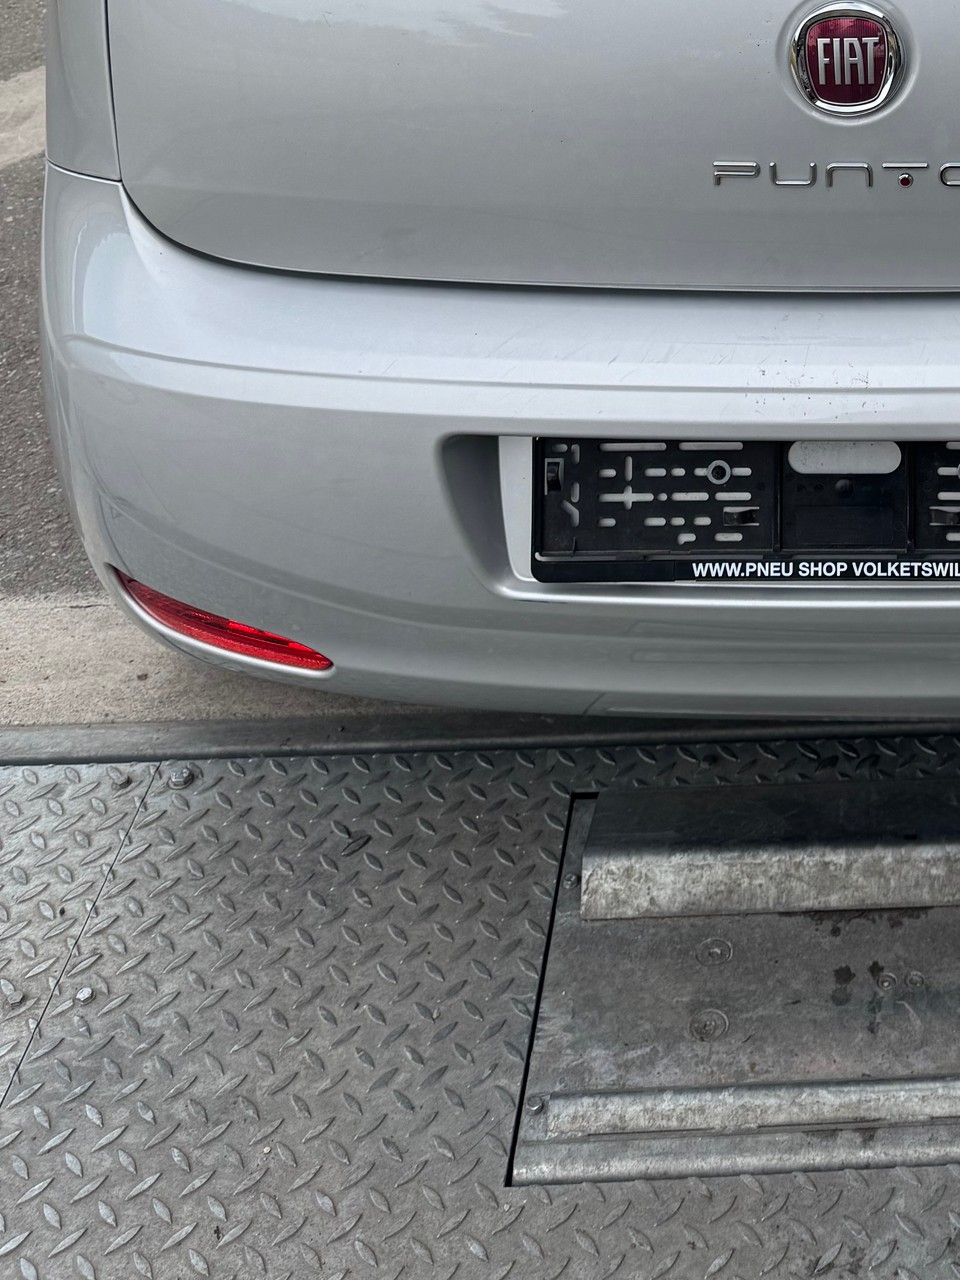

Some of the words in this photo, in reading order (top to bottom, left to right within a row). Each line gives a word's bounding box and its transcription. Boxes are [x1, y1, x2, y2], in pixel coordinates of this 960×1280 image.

[817, 37, 880, 84] FIAT
[692, 561, 794, 577] WWW.PNEU
[798, 561, 848, 577] SHOP
